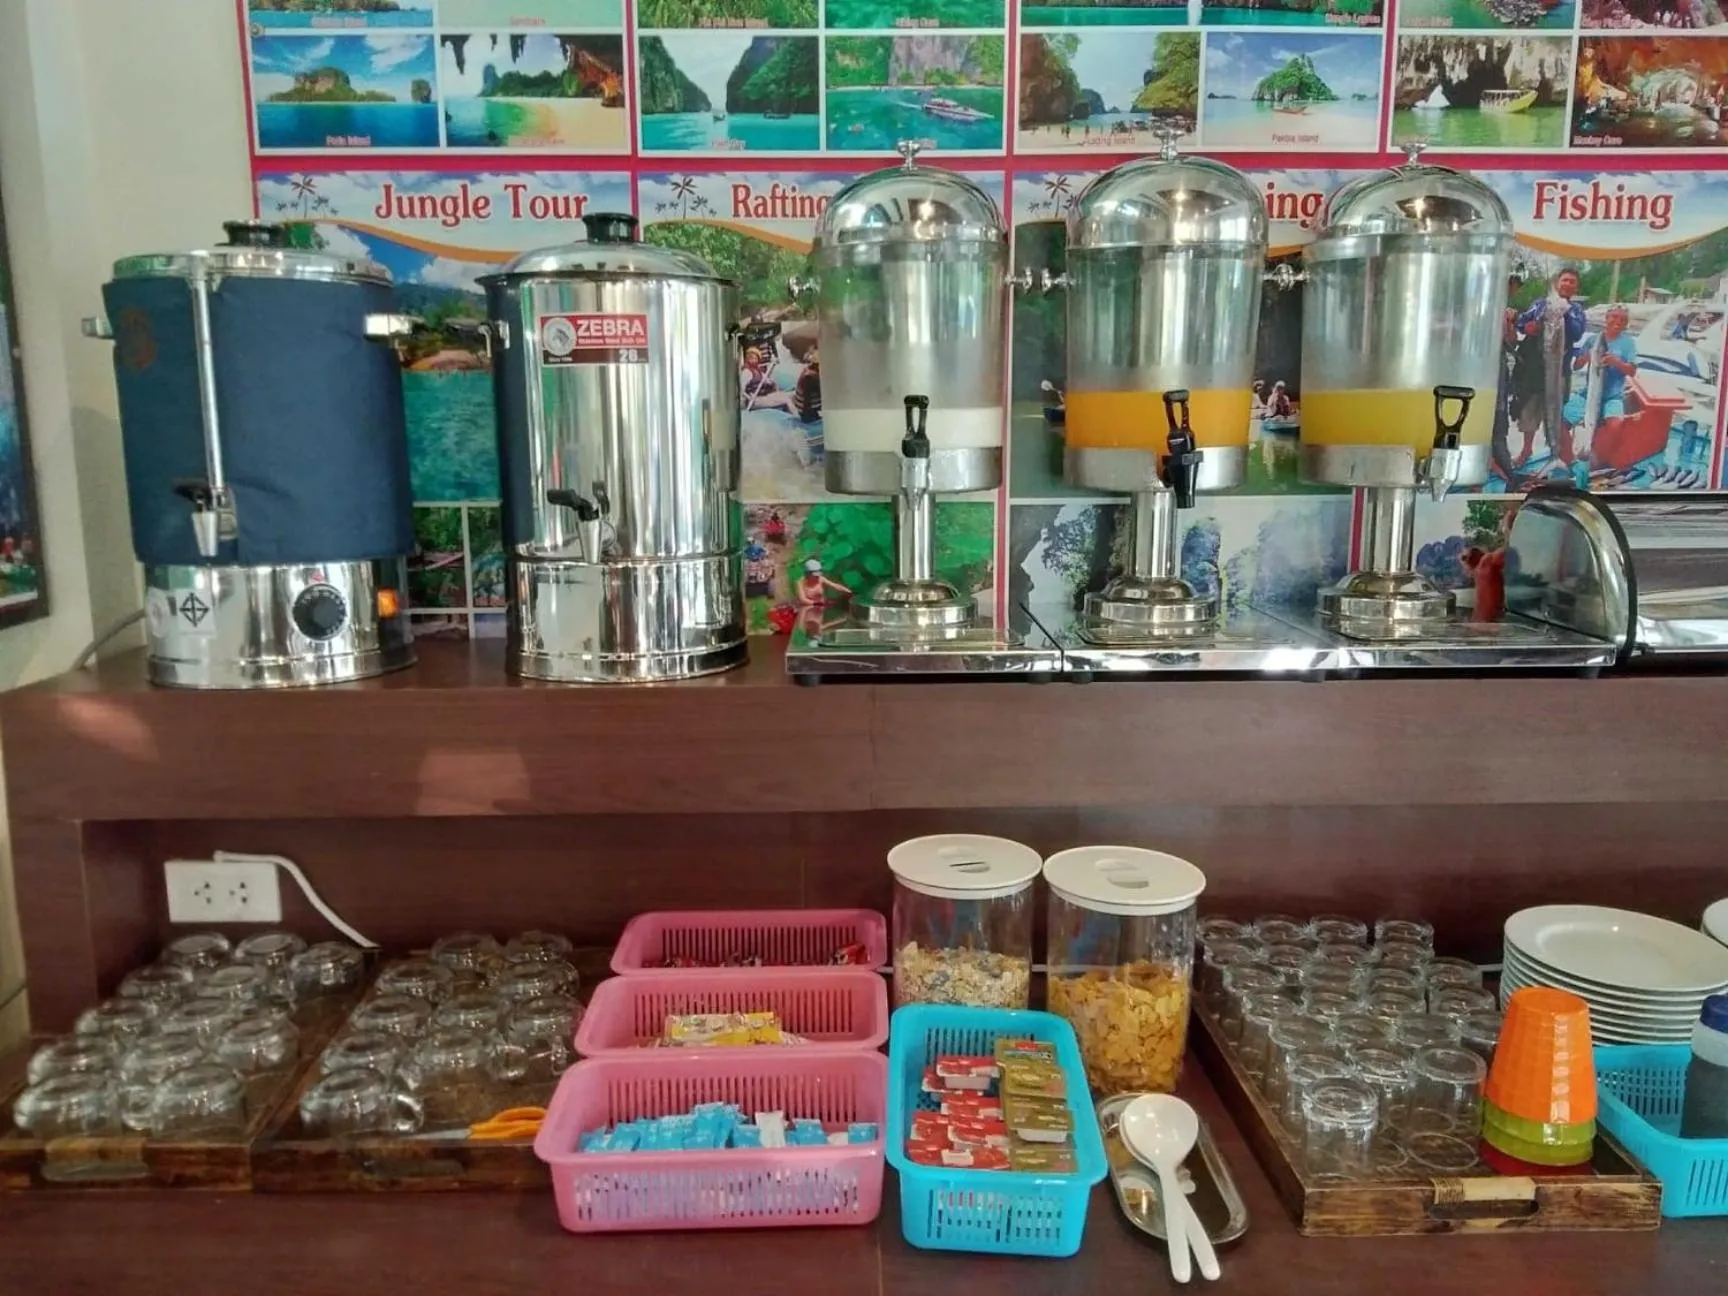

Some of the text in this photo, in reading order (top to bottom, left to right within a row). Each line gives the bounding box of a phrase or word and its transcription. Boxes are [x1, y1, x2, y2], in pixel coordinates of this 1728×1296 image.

[374, 182, 589, 228] Jungle Tour
[1533, 181, 1673, 230] Fishing
[576, 318, 645, 336] ZEBRA
